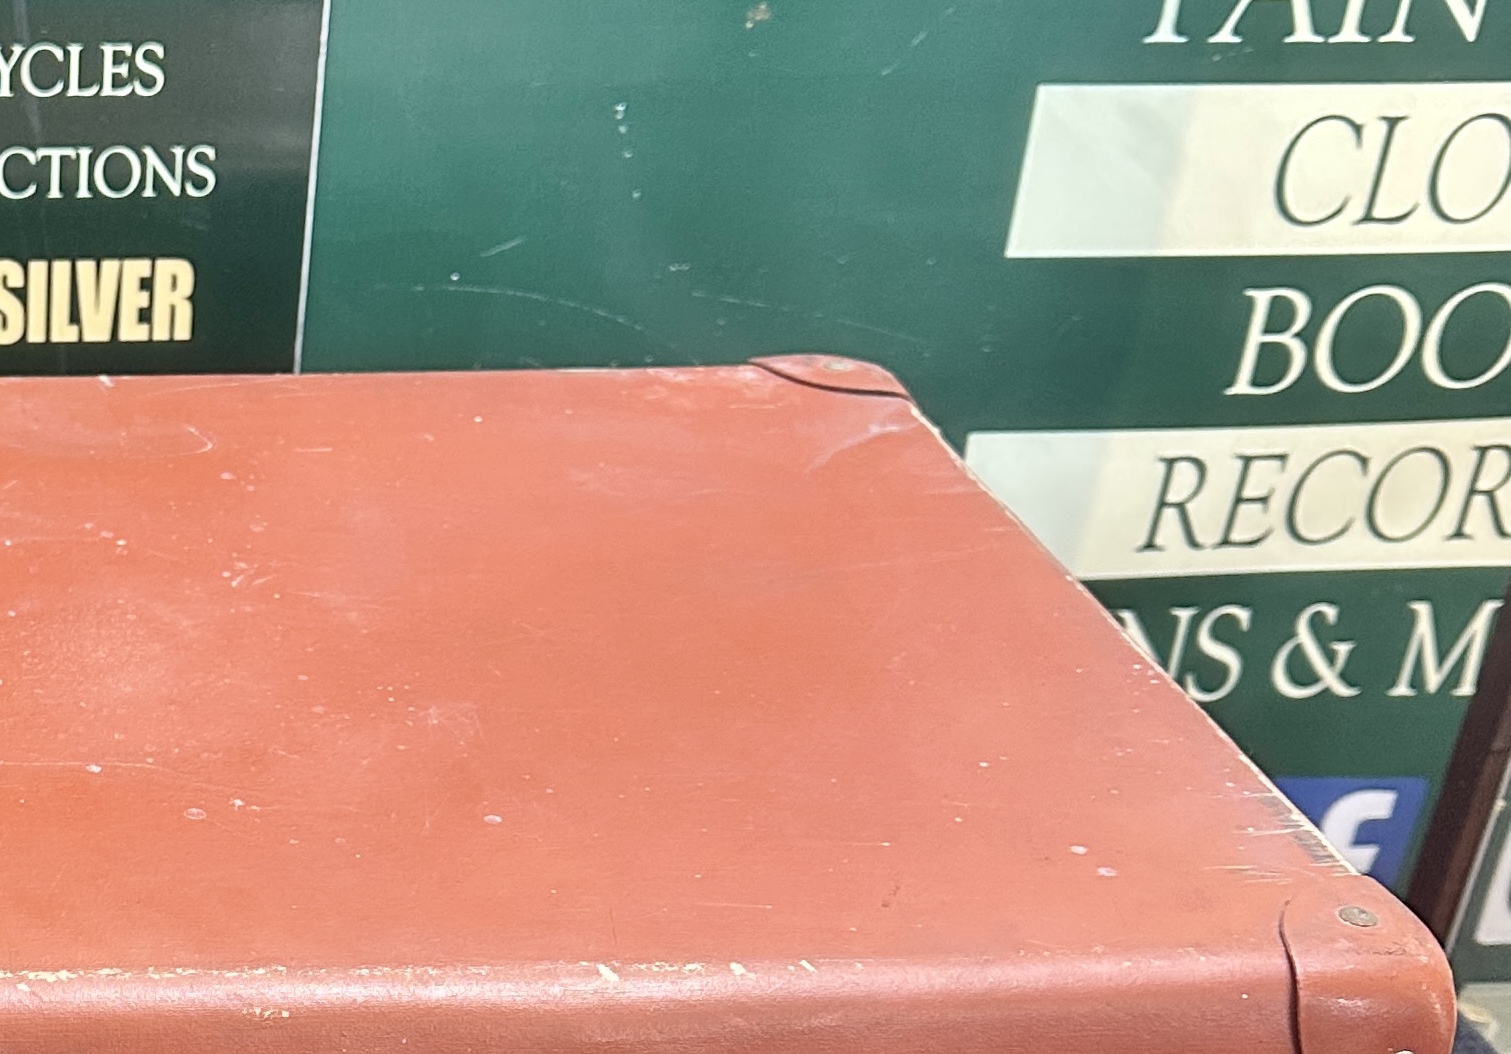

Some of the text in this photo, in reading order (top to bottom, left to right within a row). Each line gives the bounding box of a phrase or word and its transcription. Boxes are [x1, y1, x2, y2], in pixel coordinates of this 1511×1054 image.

[1275, 113, 1511, 227] CLO
[1224, 282, 1511, 396] BOO
[1136, 444, 1511, 552] RECOR
[1271, 602, 1362, 700] &
